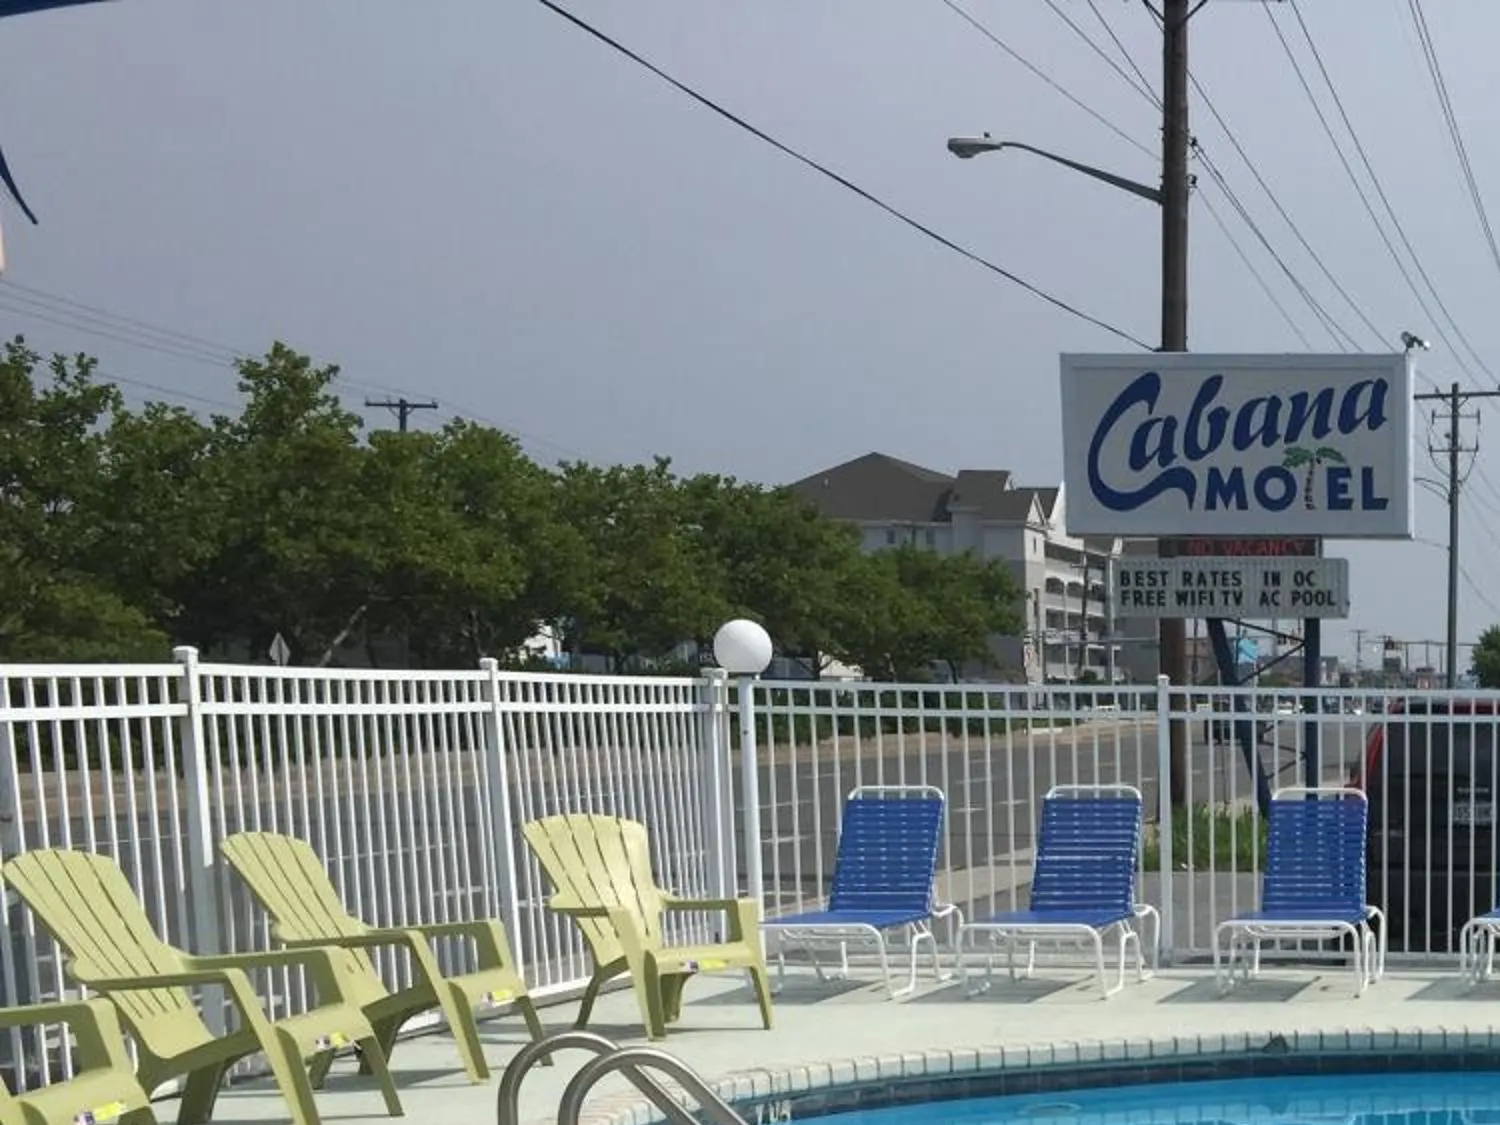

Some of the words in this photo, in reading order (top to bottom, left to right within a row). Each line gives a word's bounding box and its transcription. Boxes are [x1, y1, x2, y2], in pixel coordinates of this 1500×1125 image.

[1087, 371, 1389, 512] Cabana
[1223, 539, 1305, 556] VACANCY
[1120, 570, 1169, 587] BEST
[1182, 570, 1242, 587] RATES
[1263, 570, 1281, 587] IN
[1293, 570, 1316, 587] OC
[1120, 590, 1166, 607] FREE
[1222, 590, 1243, 607] TV
[1259, 590, 1280, 607] AC
[1291, 590, 1336, 607] POOL
